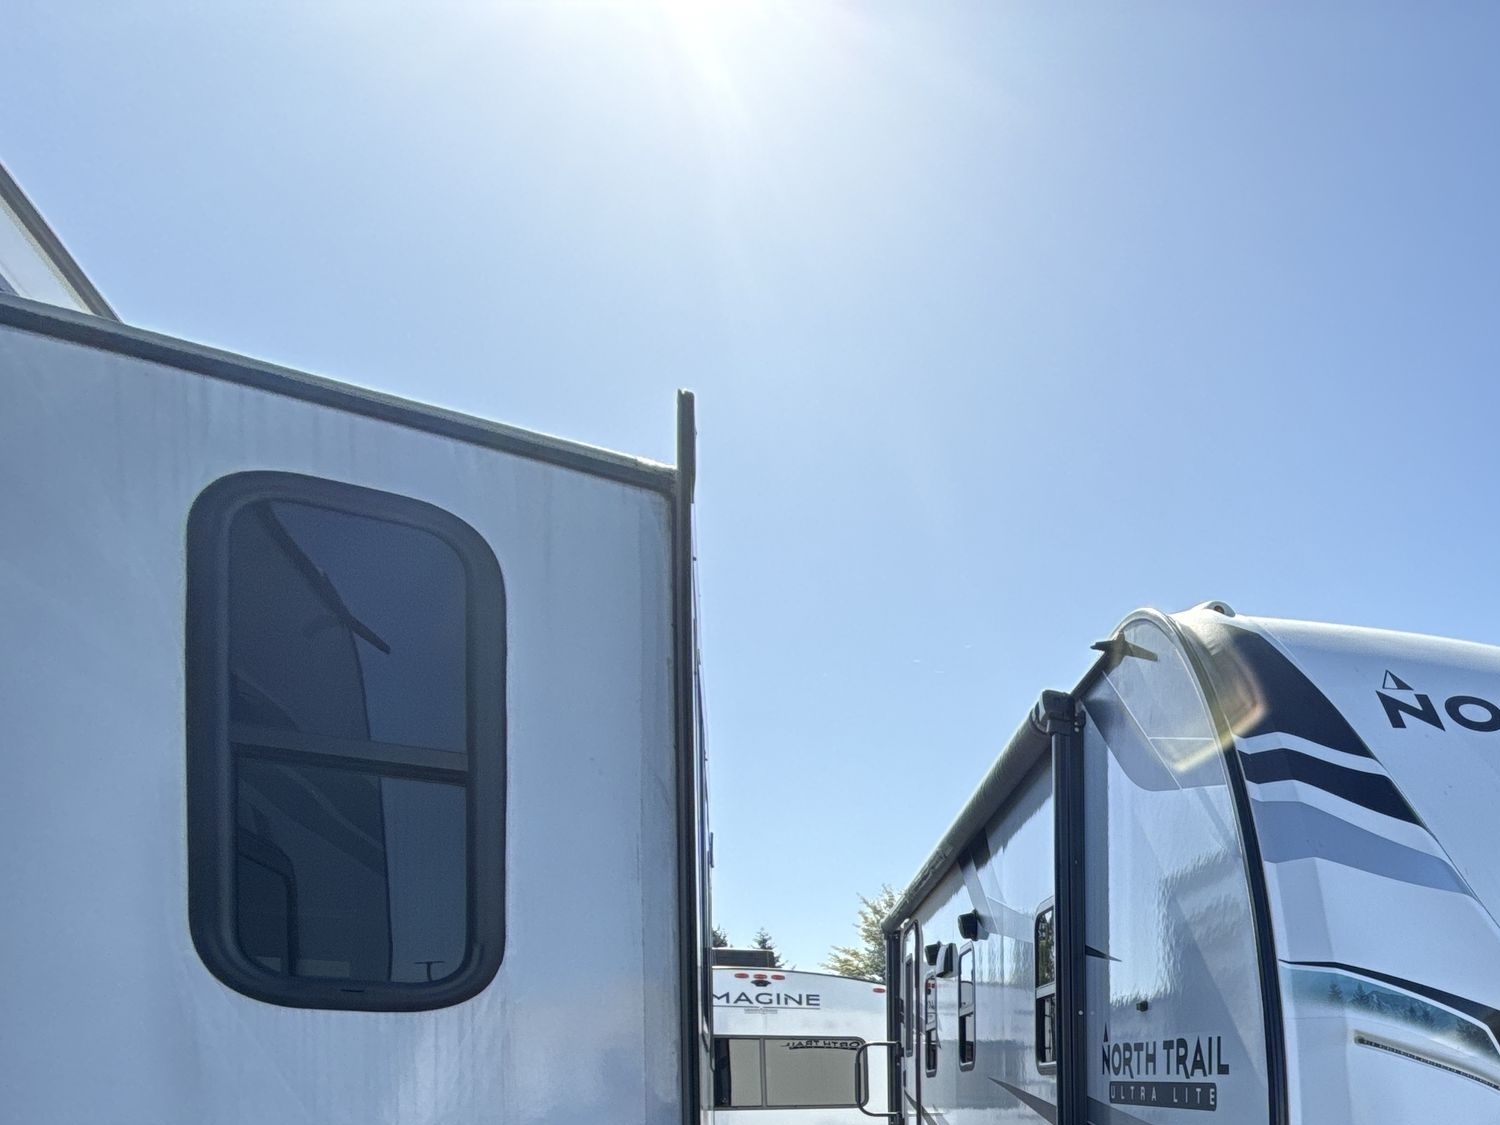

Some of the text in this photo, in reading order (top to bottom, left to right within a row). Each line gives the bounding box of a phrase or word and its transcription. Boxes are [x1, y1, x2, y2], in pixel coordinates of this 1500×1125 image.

[712, 991, 821, 1007] MAGINE
[1102, 1035, 1230, 1079] NORTH TRAIL
[1110, 1085, 1216, 1106] ULTRA LITE
